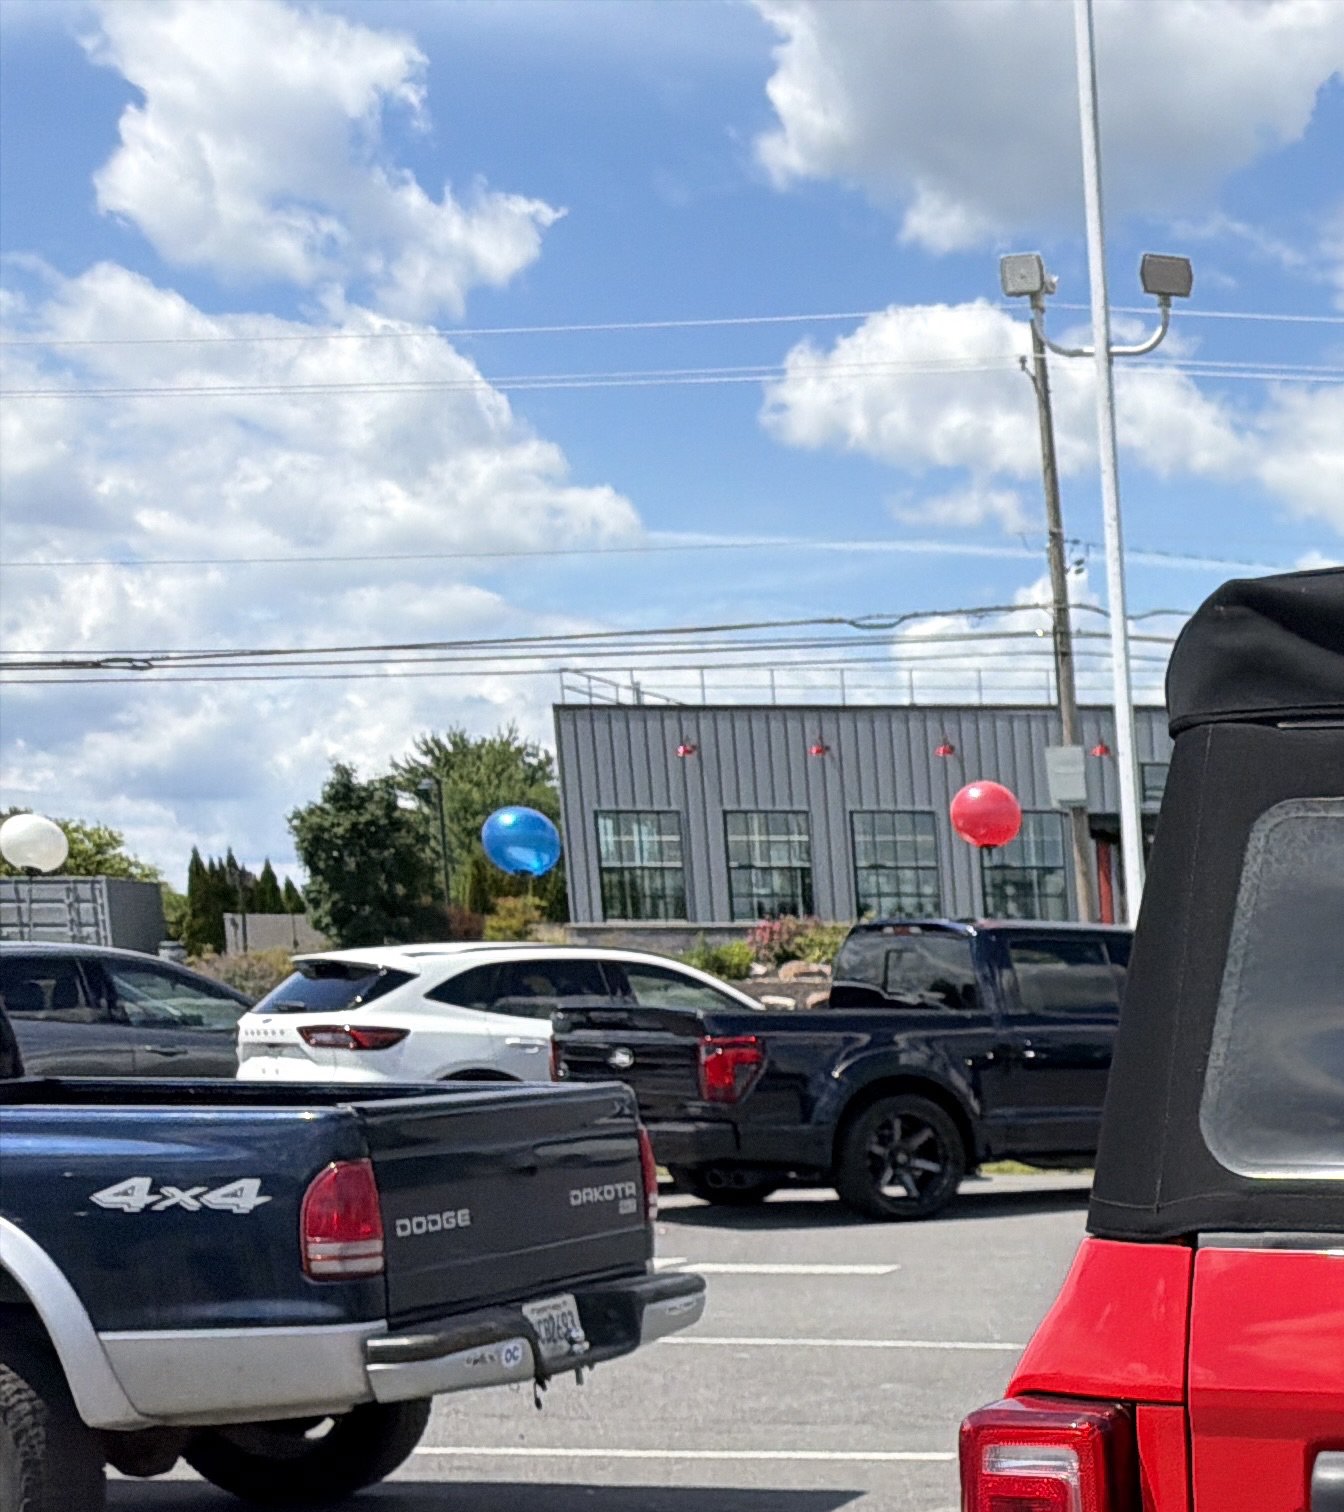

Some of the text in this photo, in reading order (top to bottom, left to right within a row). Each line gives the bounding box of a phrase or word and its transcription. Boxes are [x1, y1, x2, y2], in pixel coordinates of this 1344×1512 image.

[90, 1177, 272, 1213] 4x4
[569, 1181, 636, 1206] DAKOTA
[396, 1208, 471, 1237] DODGE
